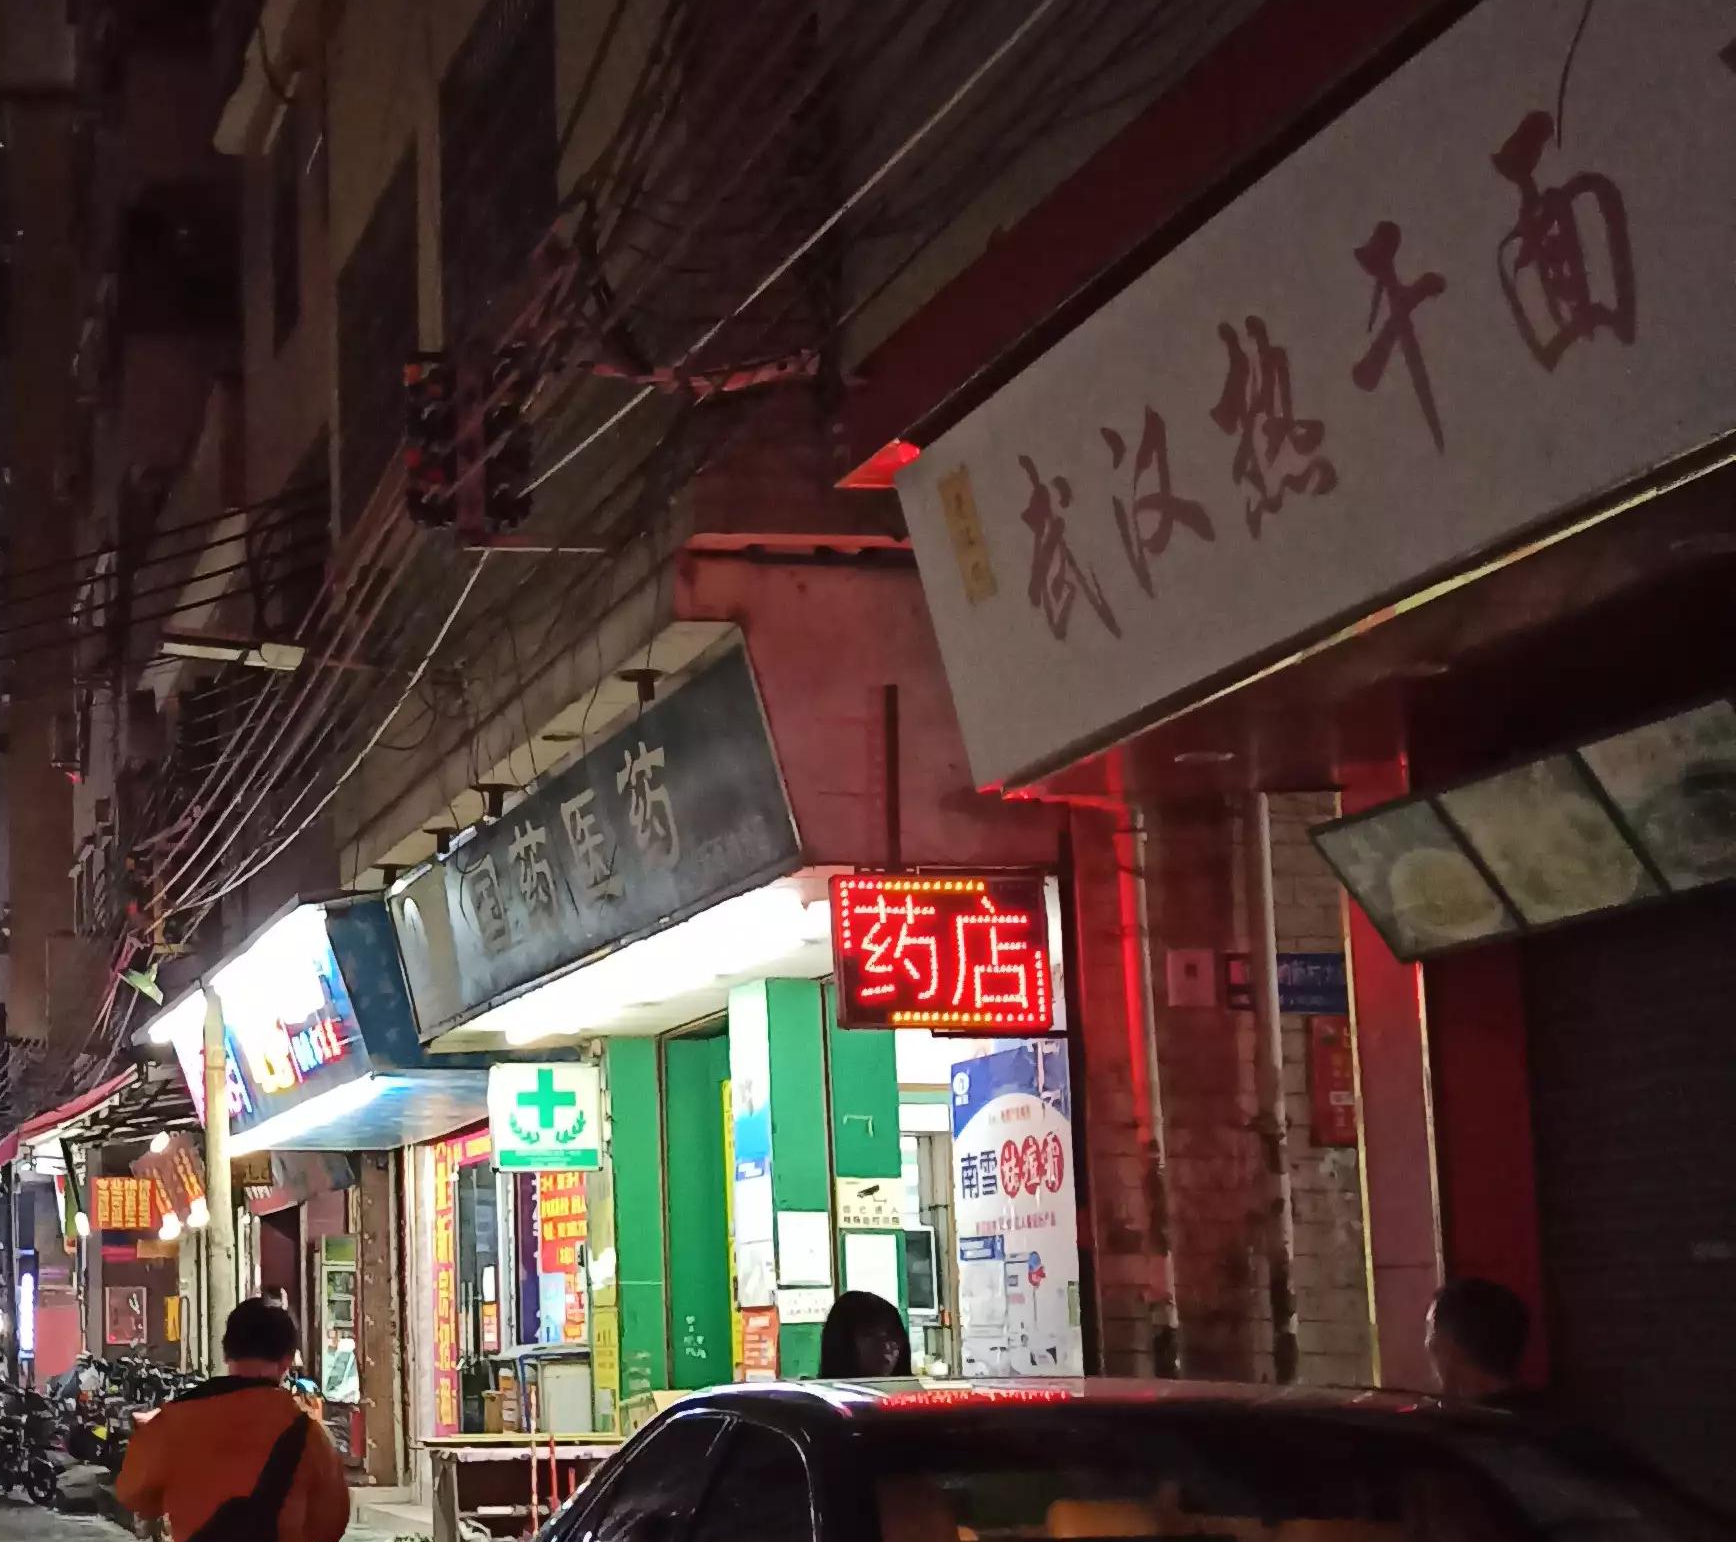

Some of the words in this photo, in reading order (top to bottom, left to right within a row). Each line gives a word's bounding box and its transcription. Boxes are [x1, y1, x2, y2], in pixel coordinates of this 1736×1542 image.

[1019, 110, 1636, 642] 武汉热干面
[853, 894, 1029, 1009] 药店
